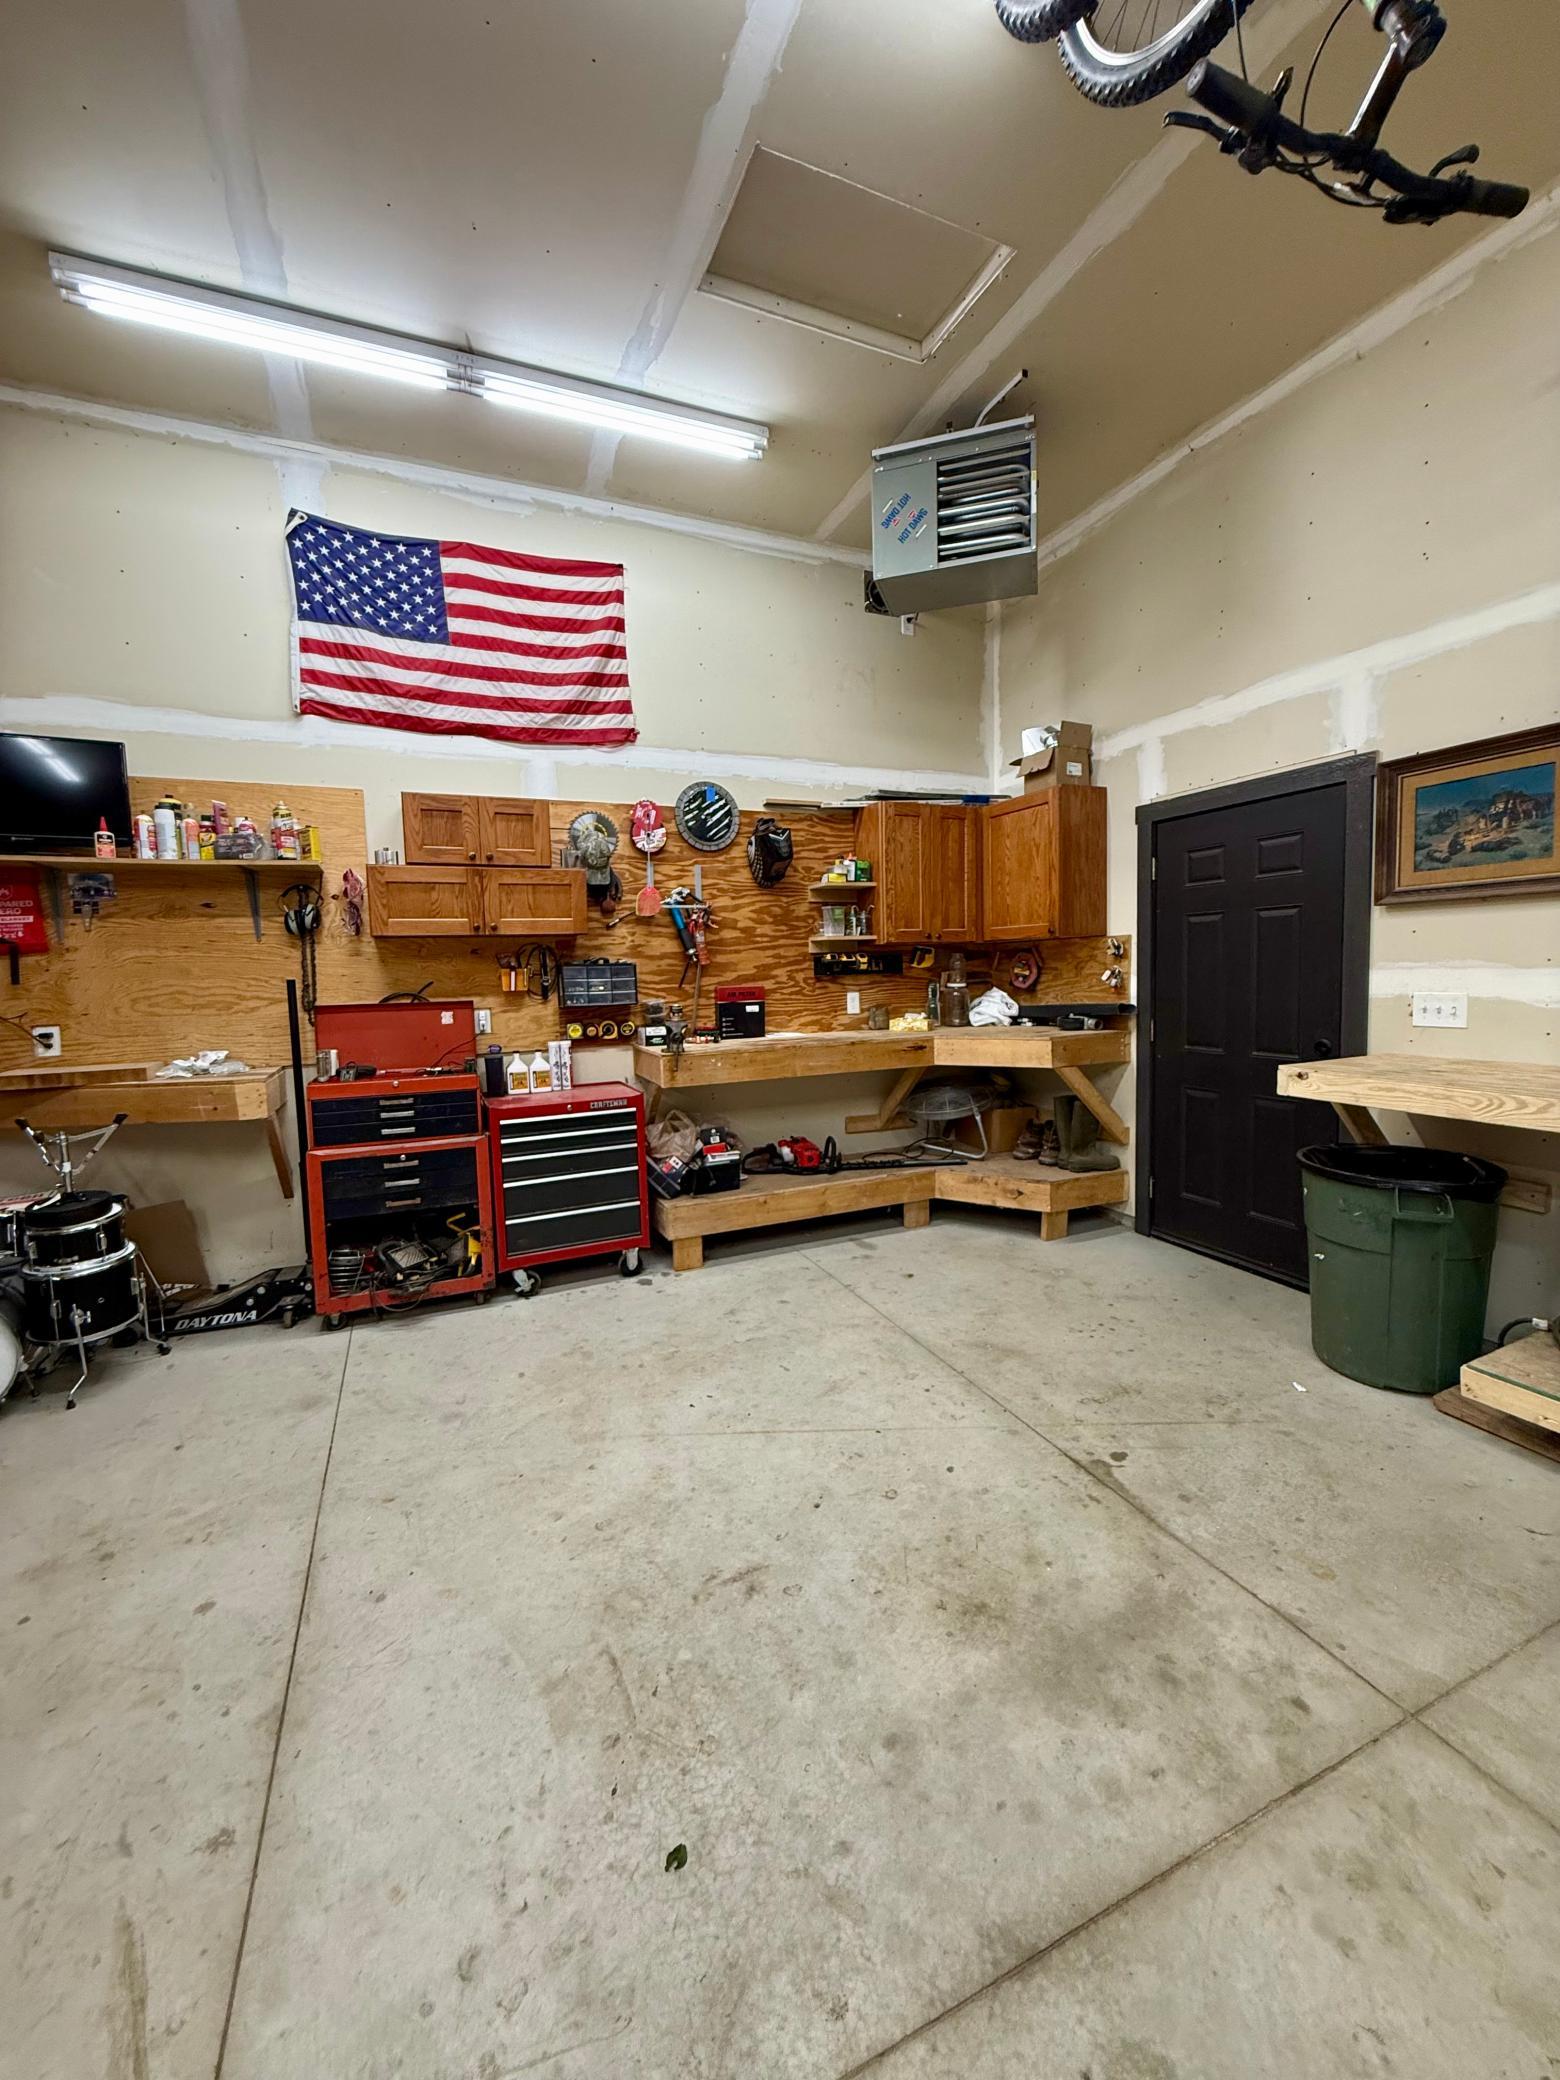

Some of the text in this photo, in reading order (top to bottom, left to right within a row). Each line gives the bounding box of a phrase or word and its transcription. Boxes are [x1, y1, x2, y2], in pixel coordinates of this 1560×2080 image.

[881, 492, 912, 529] HOT DAWG
[897, 507, 929, 544] HOT DAWG
[590, 1098, 628, 1109] CRAFTSMAN
[174, 1310, 257, 1331] DAYTONA
